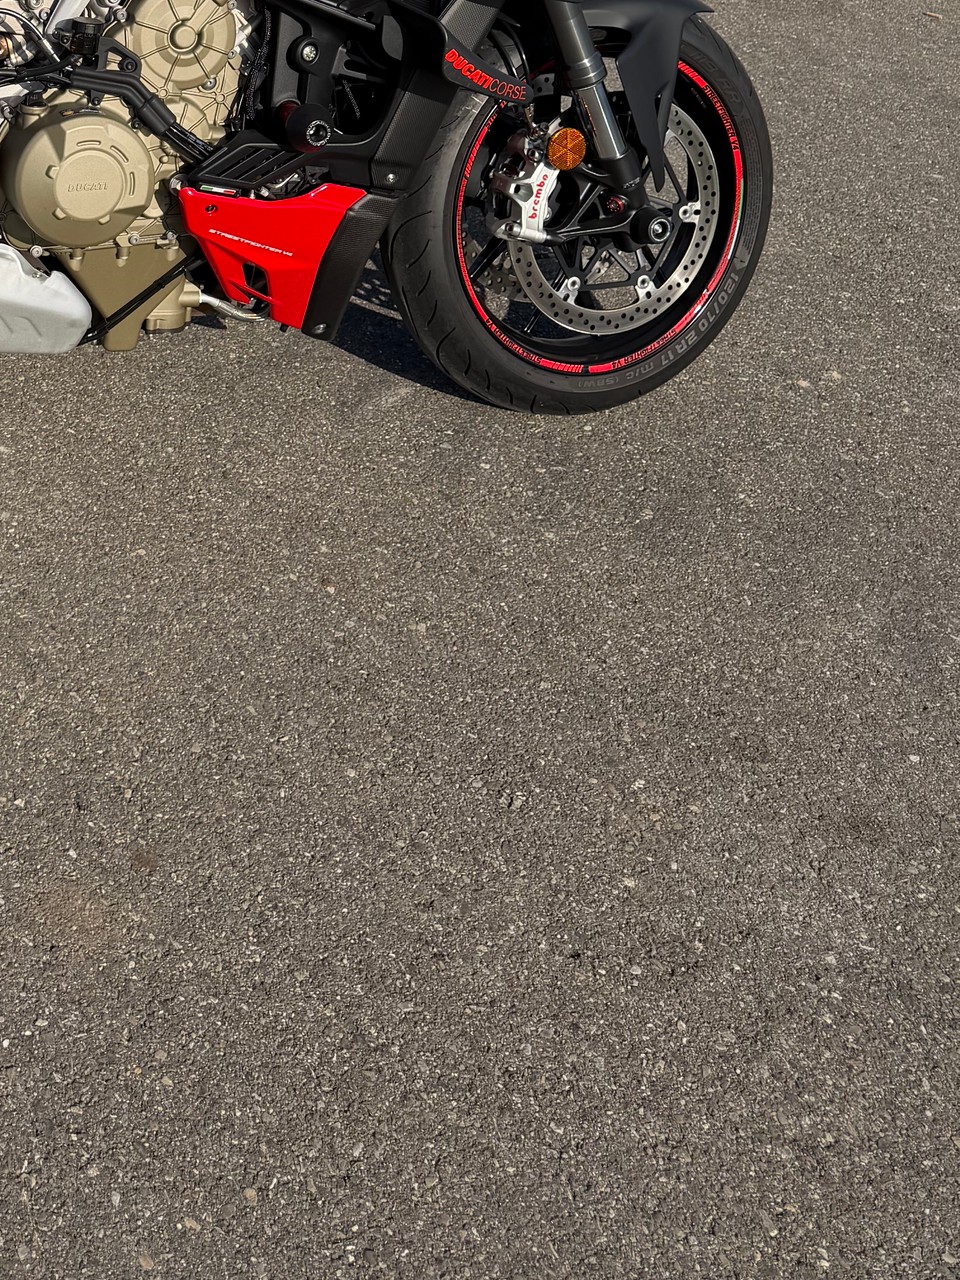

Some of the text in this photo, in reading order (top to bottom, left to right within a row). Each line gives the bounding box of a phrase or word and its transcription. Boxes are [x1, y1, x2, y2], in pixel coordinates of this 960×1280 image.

[67, 181, 109, 193] DUCATI
[528, 173, 549, 220] brembo
[698, 273, 739, 332] 120/70
